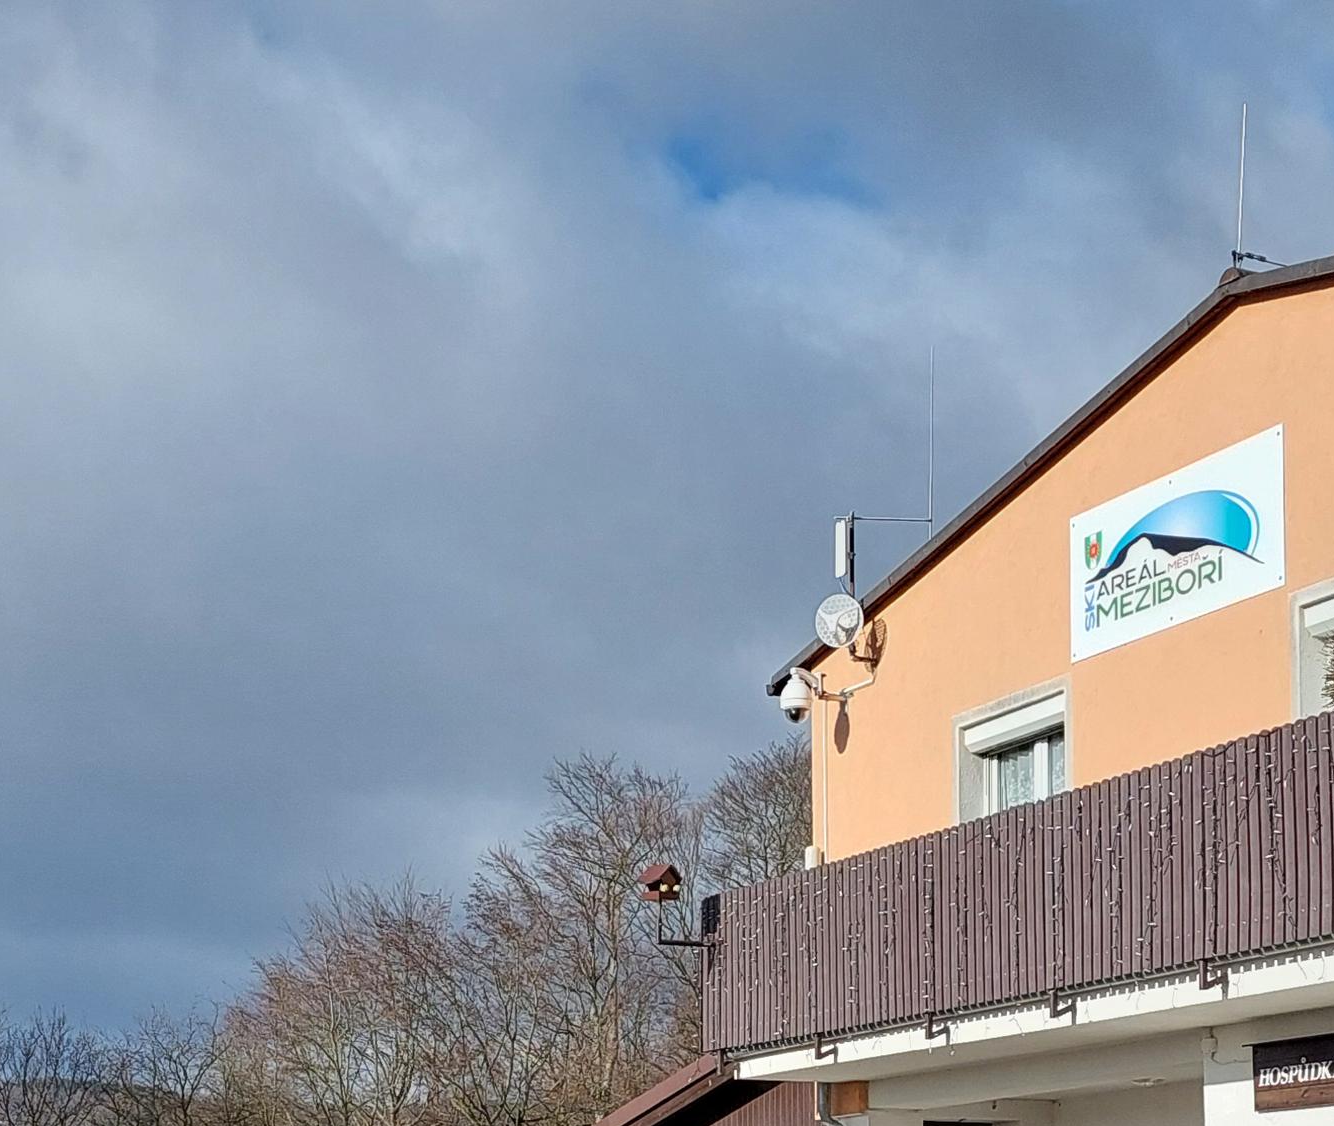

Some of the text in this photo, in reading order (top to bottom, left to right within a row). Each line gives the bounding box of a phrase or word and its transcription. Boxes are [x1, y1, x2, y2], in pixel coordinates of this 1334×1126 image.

[1095, 549, 1223, 628] MEZIBOŘÍ
[1096, 559, 1166, 600] AREÁL
[1084, 584, 1096, 632] SKI
